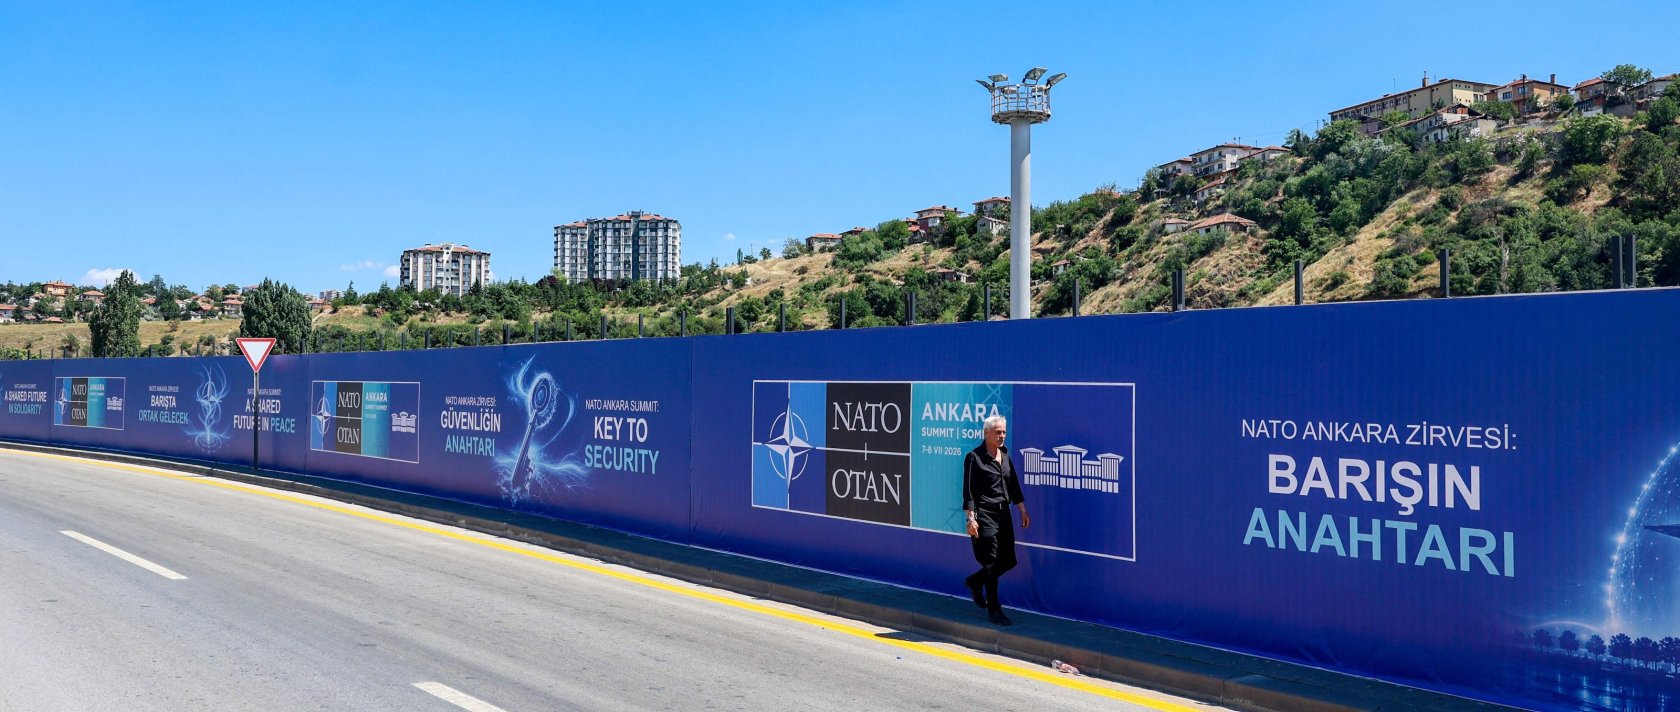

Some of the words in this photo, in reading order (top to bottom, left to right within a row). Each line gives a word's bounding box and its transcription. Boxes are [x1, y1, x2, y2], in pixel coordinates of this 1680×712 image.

[9, 391, 27, 401] SHARED
[28, 392, 47, 402] FUTURE
[72, 384, 87, 395] NATO
[365, 392, 388, 402] ANKARA
[151, 395, 176, 410] BARIŞTA
[246, 399, 251, 412] A
[338, 392, 360, 408] NATO
[445, 396, 457, 405] NATO
[458, 396, 476, 406] ANKARA
[585, 399, 602, 410] NATO
[602, 400, 629, 411] ANKARA
[630, 400, 659, 412] SUMMIT:
[14, 404, 41, 414] SOLIDARITY
[72, 408, 87, 419] OTAN
[139, 410, 158, 422] ORTAK
[160, 411, 188, 424] GELECEK
[832, 401, 902, 433] NATO
[922, 402, 1000, 423] ANKARA
[262, 417, 269, 431] IN
[271, 418, 296, 433] PEACE
[441, 407, 500, 432] GÜVENLİĞİN
[337, 426, 360, 444] OTAN
[594, 416, 623, 440] KEY
[627, 418, 648, 442] TO
[922, 427, 954, 438] SUMMIT
[1242, 419, 1297, 439] NATO
[1302, 421, 1400, 444] ANKARA
[1405, 421, 1517, 450] ZİRVESİ:
[445, 435, 494, 456] ANAHTARI
[922, 445, 932, 454] 7-8
[934, 446, 942, 455] VII
[945, 447, 962, 456] 2026
[585, 444, 659, 474] SECURITY
[832, 469, 902, 505] OTAN
[1268, 454, 1480, 516] BARIŞIN
[1243, 507, 1515, 578] ANAHTARI
